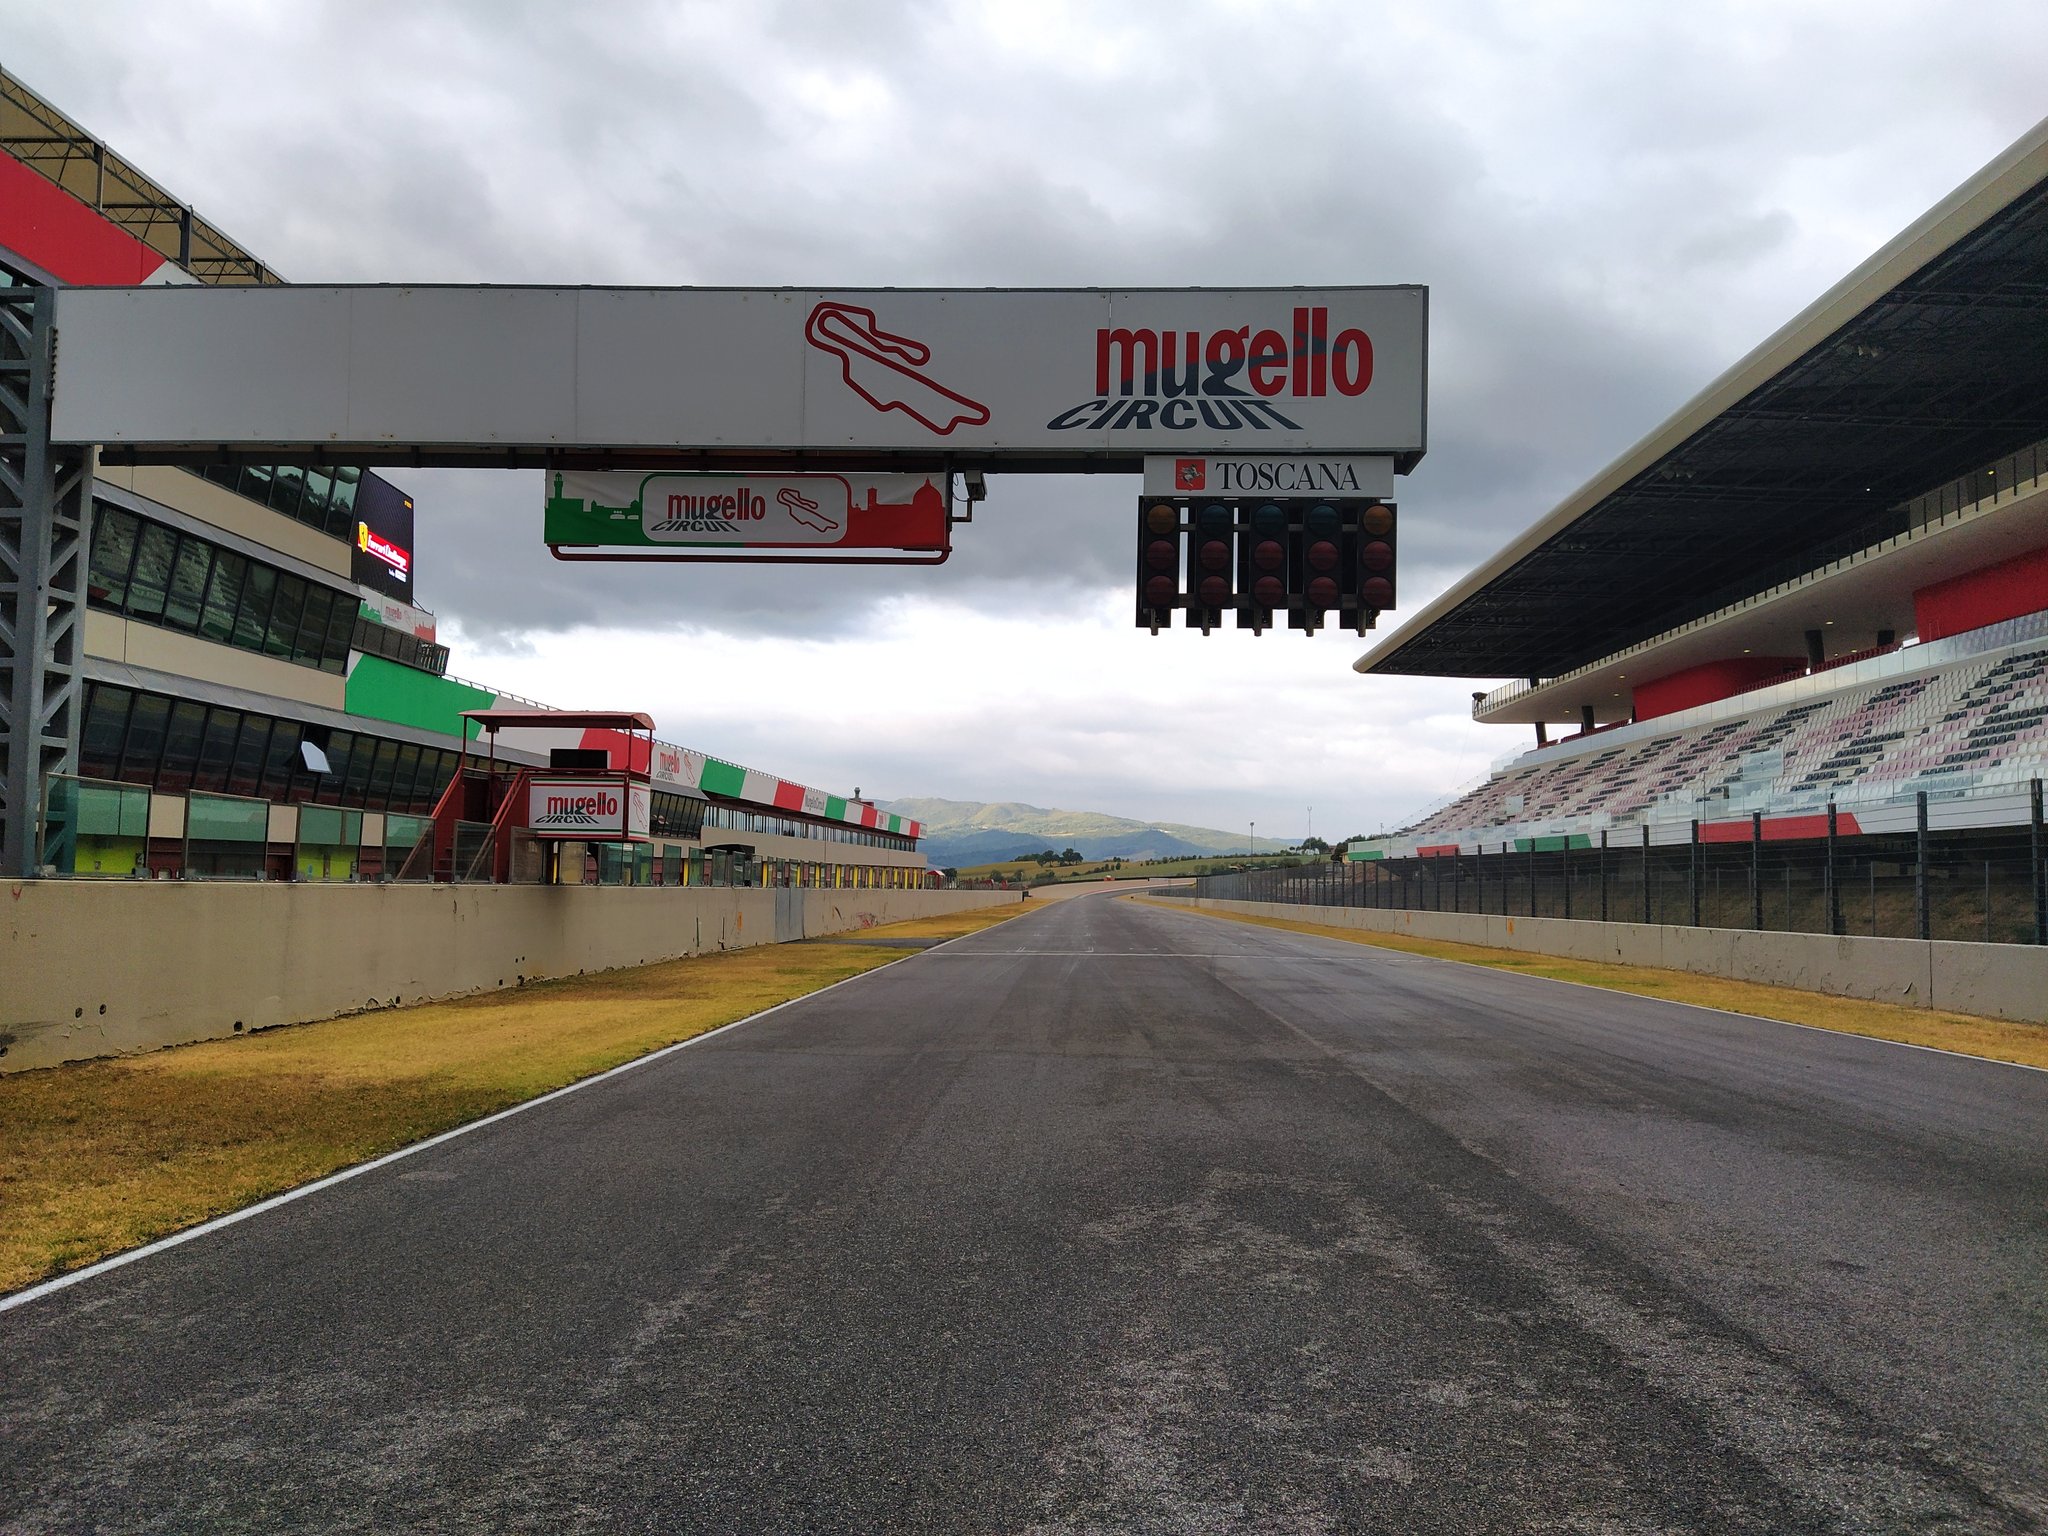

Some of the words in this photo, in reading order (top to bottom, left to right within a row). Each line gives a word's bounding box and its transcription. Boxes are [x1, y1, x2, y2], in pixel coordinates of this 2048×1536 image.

[1096, 307, 1374, 397] mugello
[1046, 399, 1305, 430] CIRCUIT
[1215, 462, 1362, 491] TOSCANA
[667, 488, 766, 520] mugello
[650, 520, 742, 532] CIRCUIT
[659, 750, 680, 774] mugello
[547, 792, 618, 816] mugello
[535, 815, 601, 825] CIRCUIT
